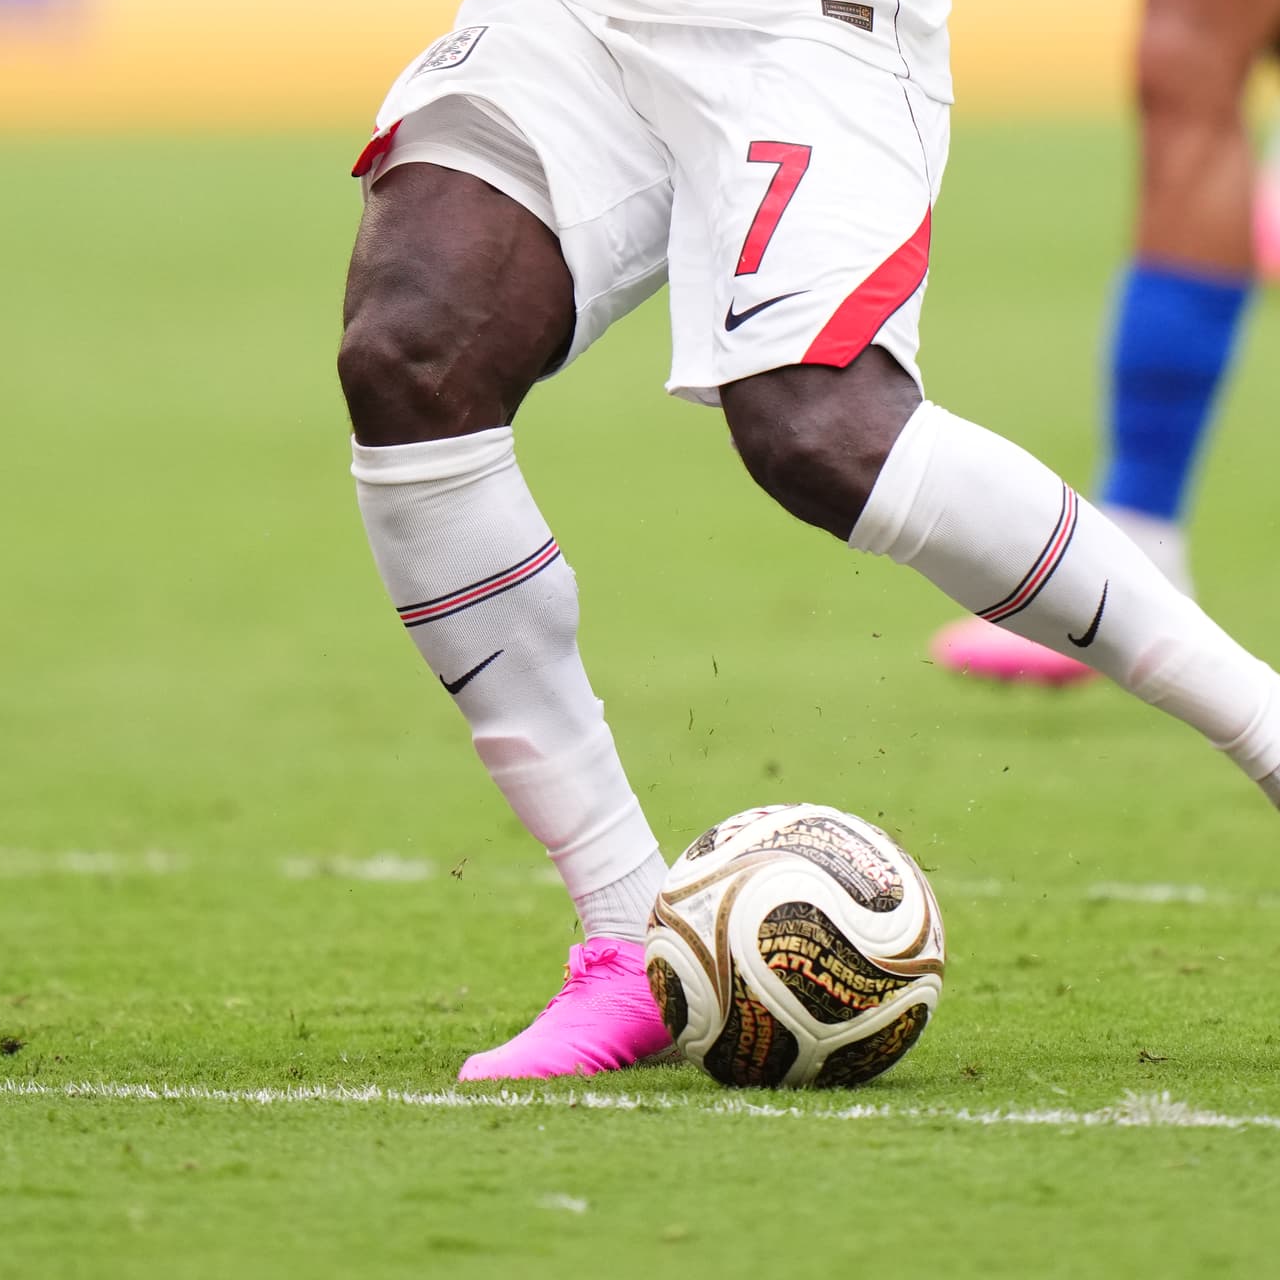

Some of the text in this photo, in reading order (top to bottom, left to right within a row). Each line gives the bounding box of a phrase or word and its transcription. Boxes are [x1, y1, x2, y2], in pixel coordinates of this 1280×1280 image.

[734, 140, 813, 277] 7
[771, 935, 821, 960] NEW
[768, 952, 880, 1011] ATLANTA
